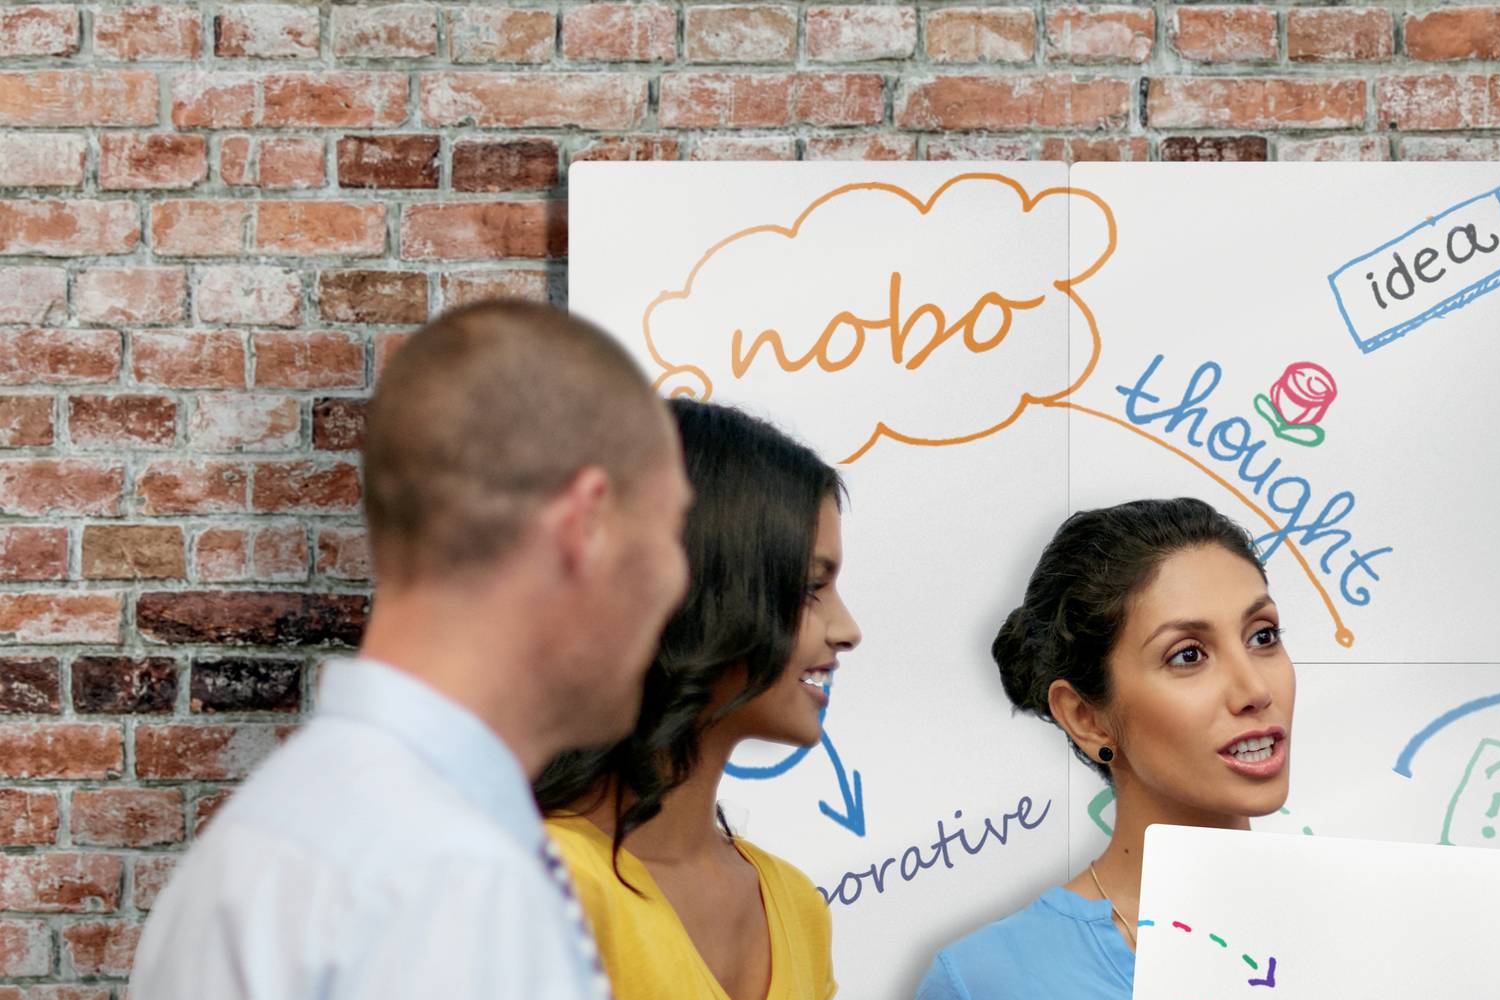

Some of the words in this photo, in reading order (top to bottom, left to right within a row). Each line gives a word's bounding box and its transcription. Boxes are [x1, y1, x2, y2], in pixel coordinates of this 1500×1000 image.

[1365, 222, 1500, 310] idea
[730, 270, 1047, 380] nobo
[1115, 353, 1394, 607] thought
